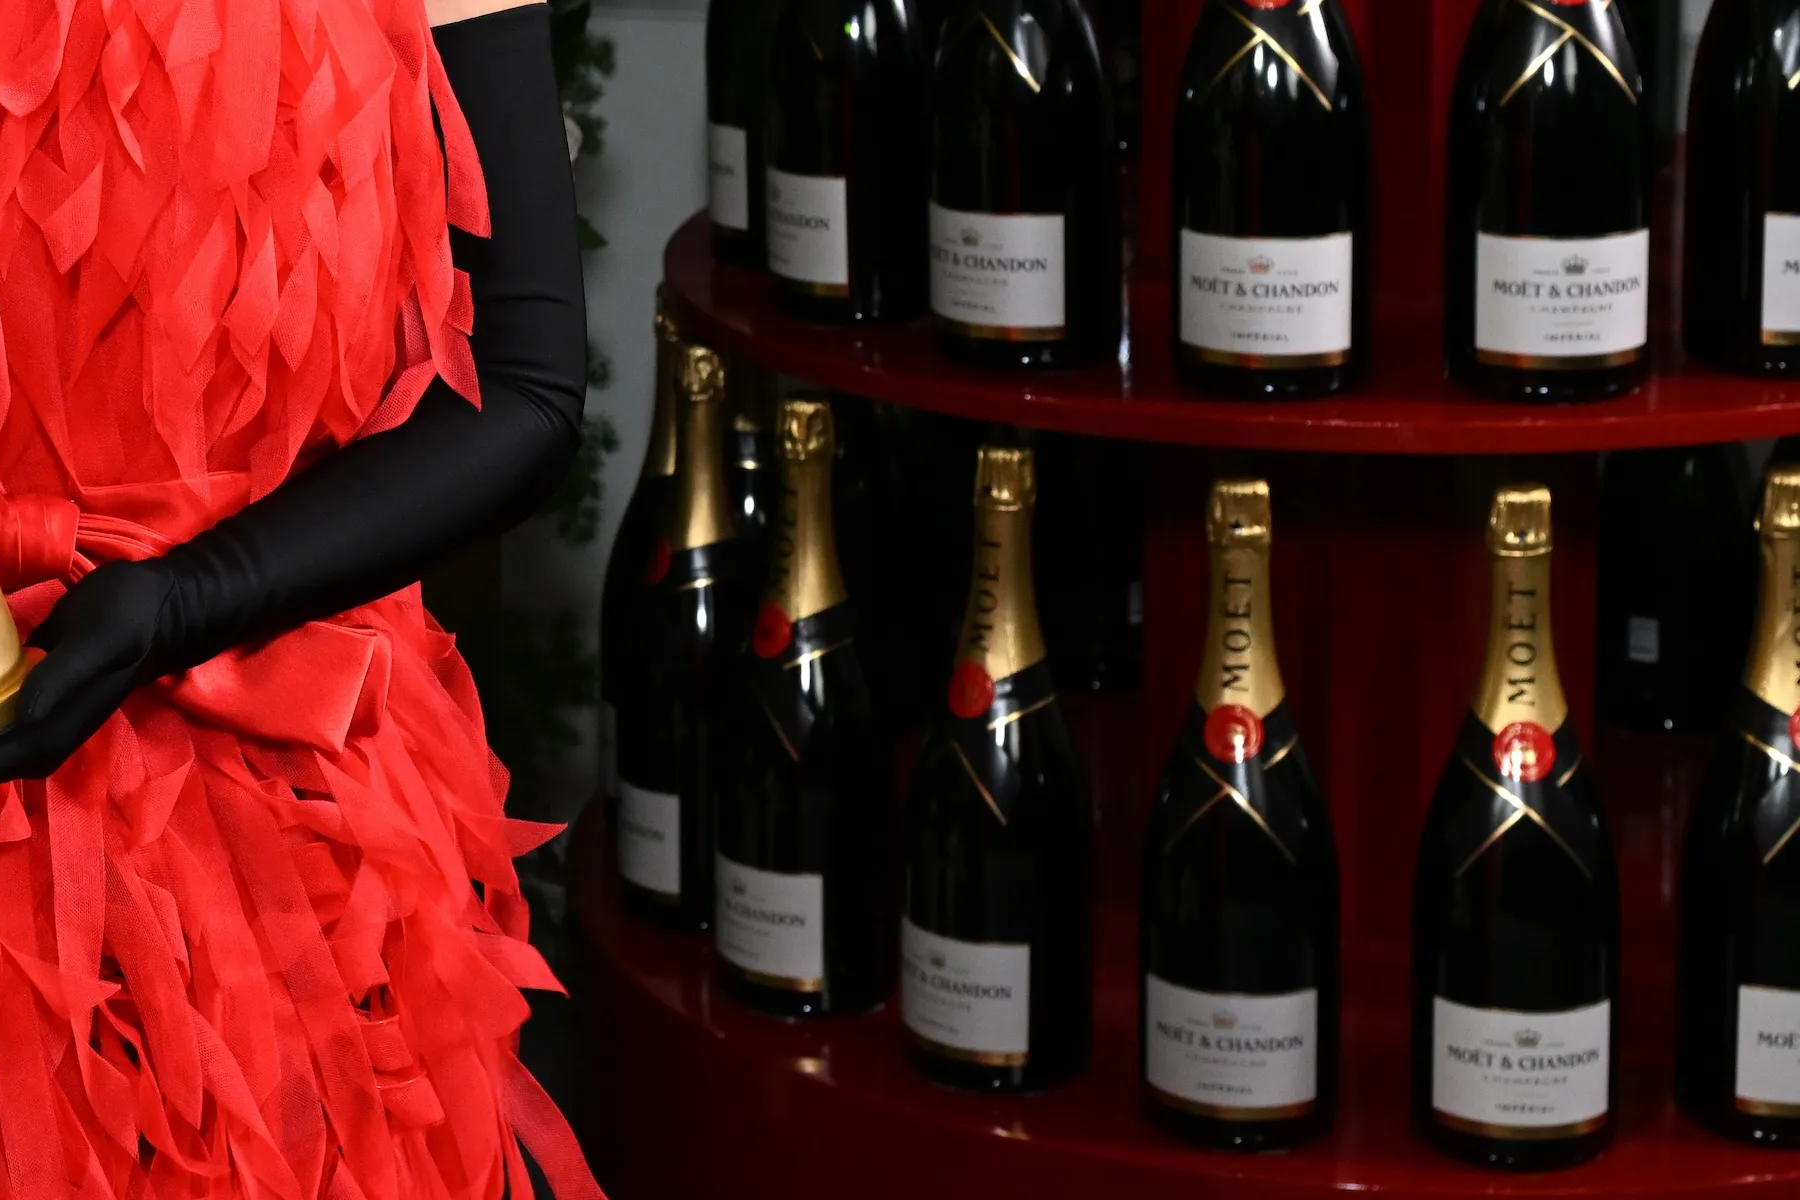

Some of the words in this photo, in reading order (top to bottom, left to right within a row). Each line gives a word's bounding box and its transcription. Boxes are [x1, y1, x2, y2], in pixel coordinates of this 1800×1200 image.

[963, 255, 1048, 273] CHANDON
[1235, 282, 1247, 297] &
[1251, 280, 1339, 300] CHANDON
[1549, 282, 1561, 299] &
[1566, 275, 1641, 299] CHANDON
[1199, 1034, 1212, 1050] &
[1215, 1035, 1304, 1054] CHANDON
[1500, 1056, 1513, 1071] &
[1517, 1047, 1600, 1072] CHANDON
